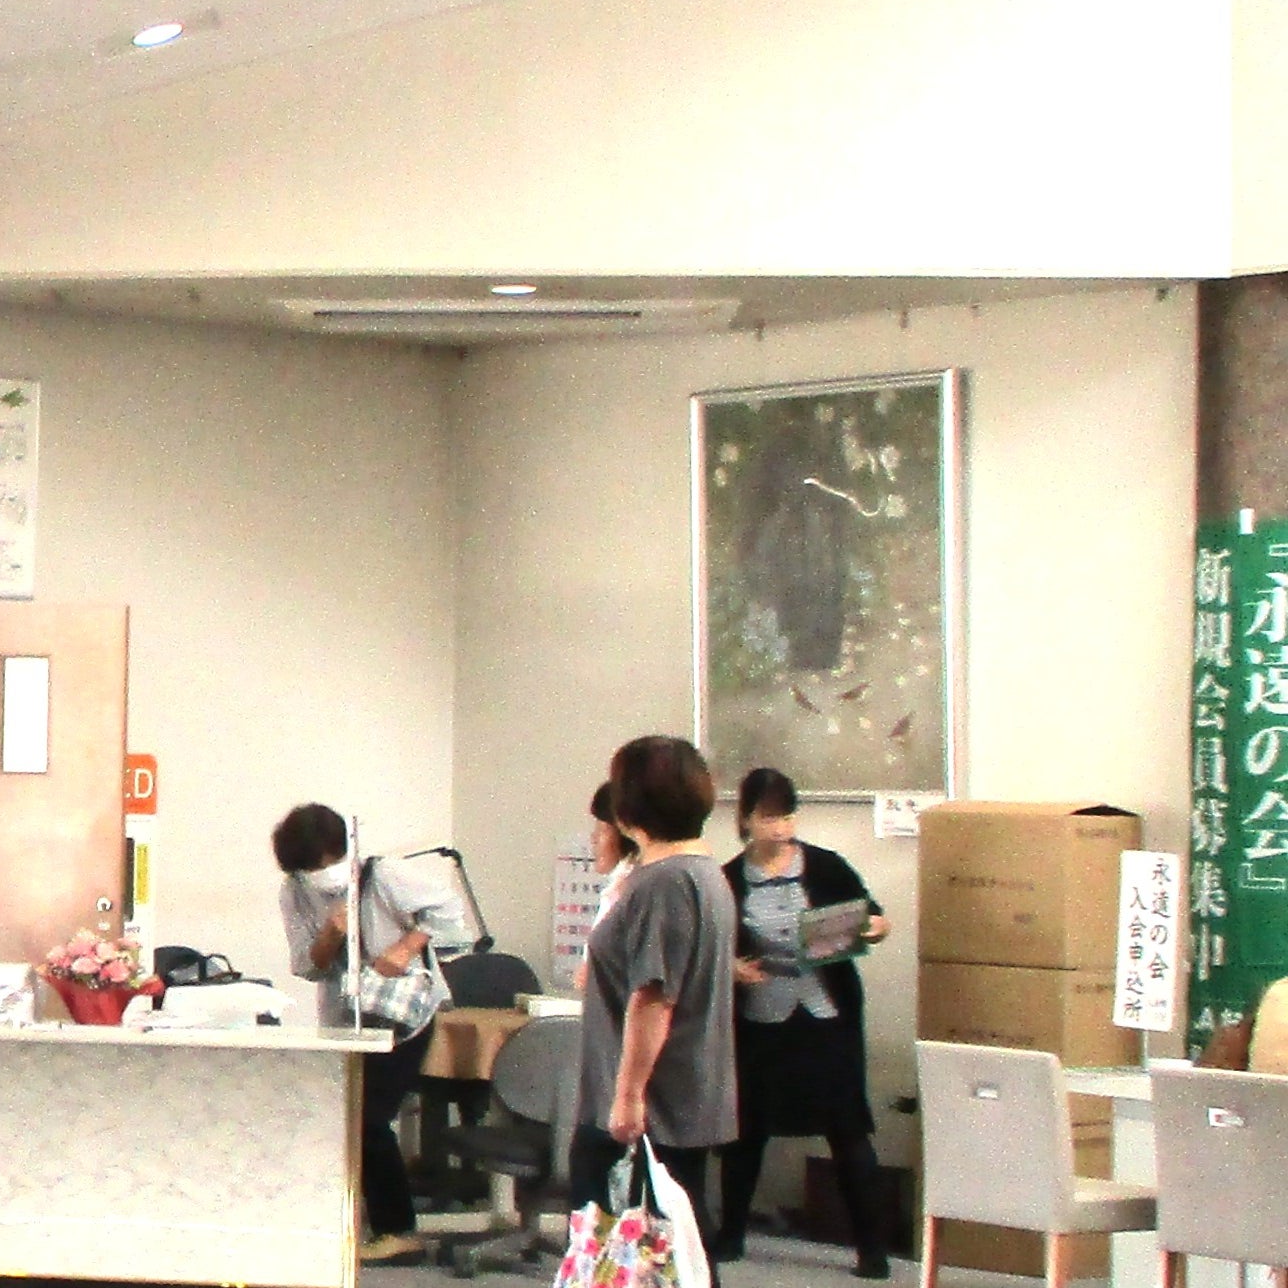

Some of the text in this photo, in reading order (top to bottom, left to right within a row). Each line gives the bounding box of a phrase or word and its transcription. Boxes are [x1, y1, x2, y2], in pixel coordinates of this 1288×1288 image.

[1124, 886, 1147, 1022] 入会申込所
[1148, 858, 1172, 981] 永遠の会
